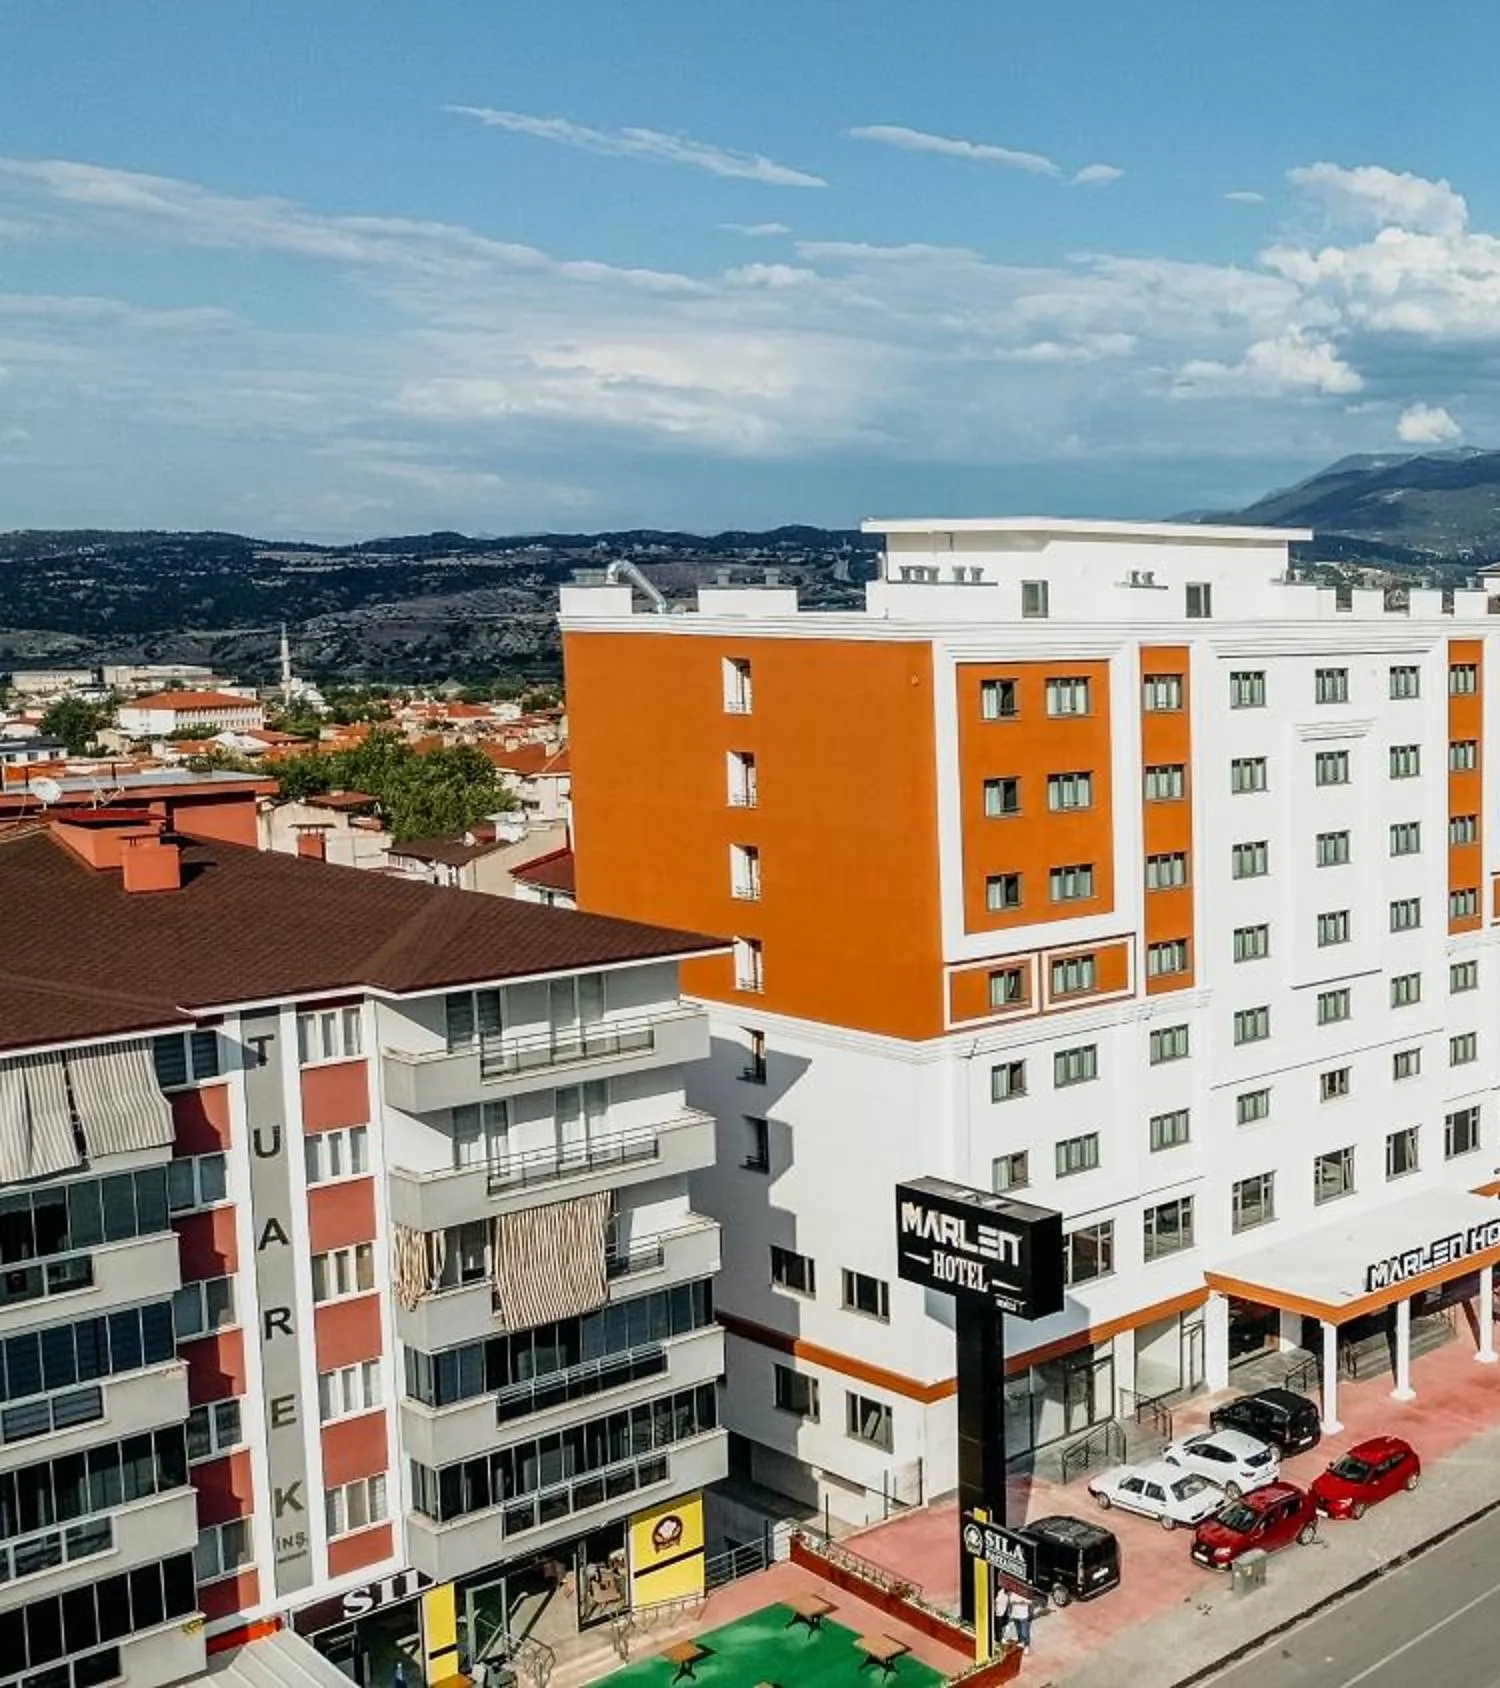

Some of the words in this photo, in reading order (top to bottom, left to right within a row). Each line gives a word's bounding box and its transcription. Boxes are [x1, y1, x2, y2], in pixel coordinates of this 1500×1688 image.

[901, 1201, 1023, 1267] MARLEN
[1367, 1234, 1464, 1292] MARLEN
[932, 1249, 990, 1292] HOTEL
